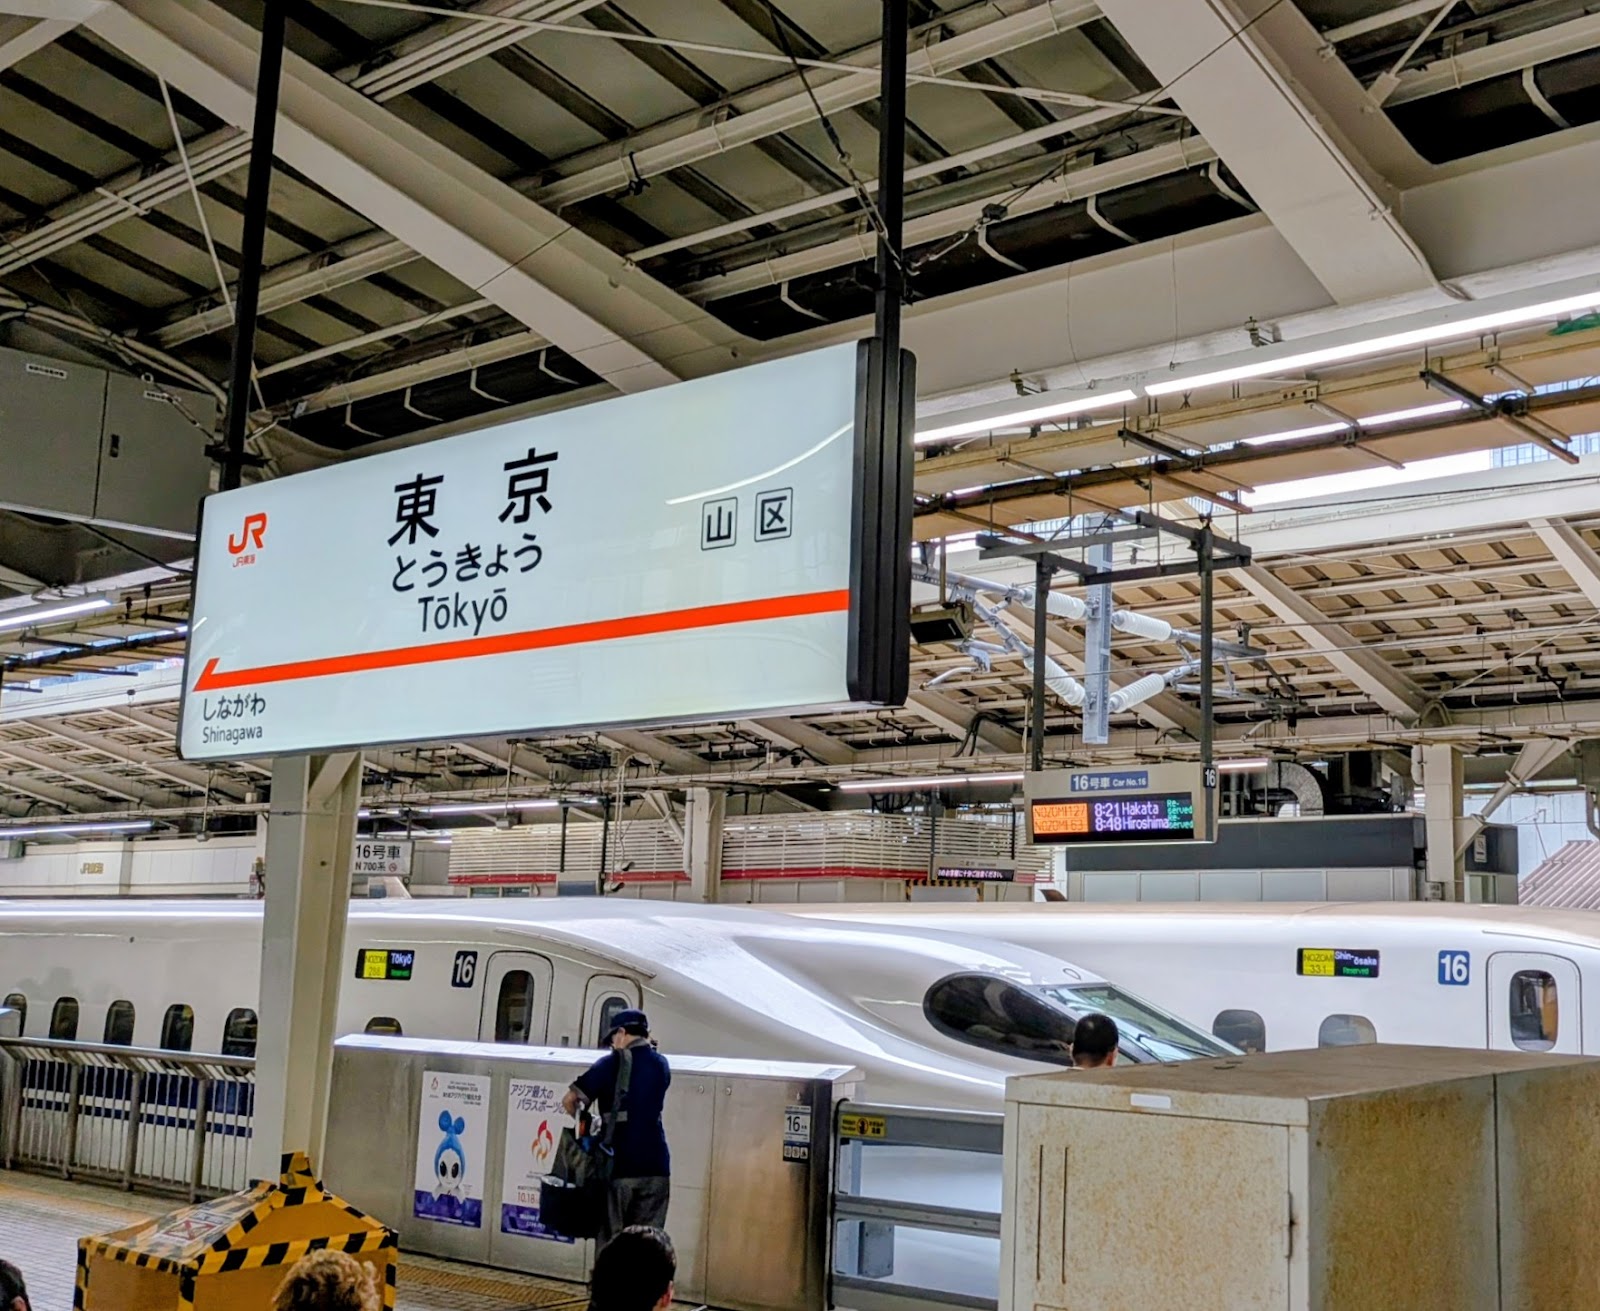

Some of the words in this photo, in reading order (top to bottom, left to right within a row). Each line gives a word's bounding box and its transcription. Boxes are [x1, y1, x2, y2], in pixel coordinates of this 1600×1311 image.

[706, 505, 733, 543] 山
[760, 495, 788, 536] 区
[228, 512, 267, 554] JR
[392, 532, 543, 592] とうきょう
[418, 587, 508, 636] Tōkyō
[202, 692, 266, 722] しながわ
[202, 724, 263, 746] Shinagawa
[1073, 775, 1110, 790] 16号車
[1112, 778, 1125, 787] Car
[1204, 769, 1216, 788] 16
[1094, 803, 1119, 818] 8:21
[1122, 801, 1159, 816] Hakata
[1095, 816, 1122, 832] 8:48
[1122, 816, 1169, 831] Hiroshima
[355, 844, 401, 860] 16号車
[456, 954, 475, 984] 16
[1440, 954, 1468, 983] 16
[510, 1083, 554, 1100] アジア最大の
[787, 1115, 801, 1132] 16
